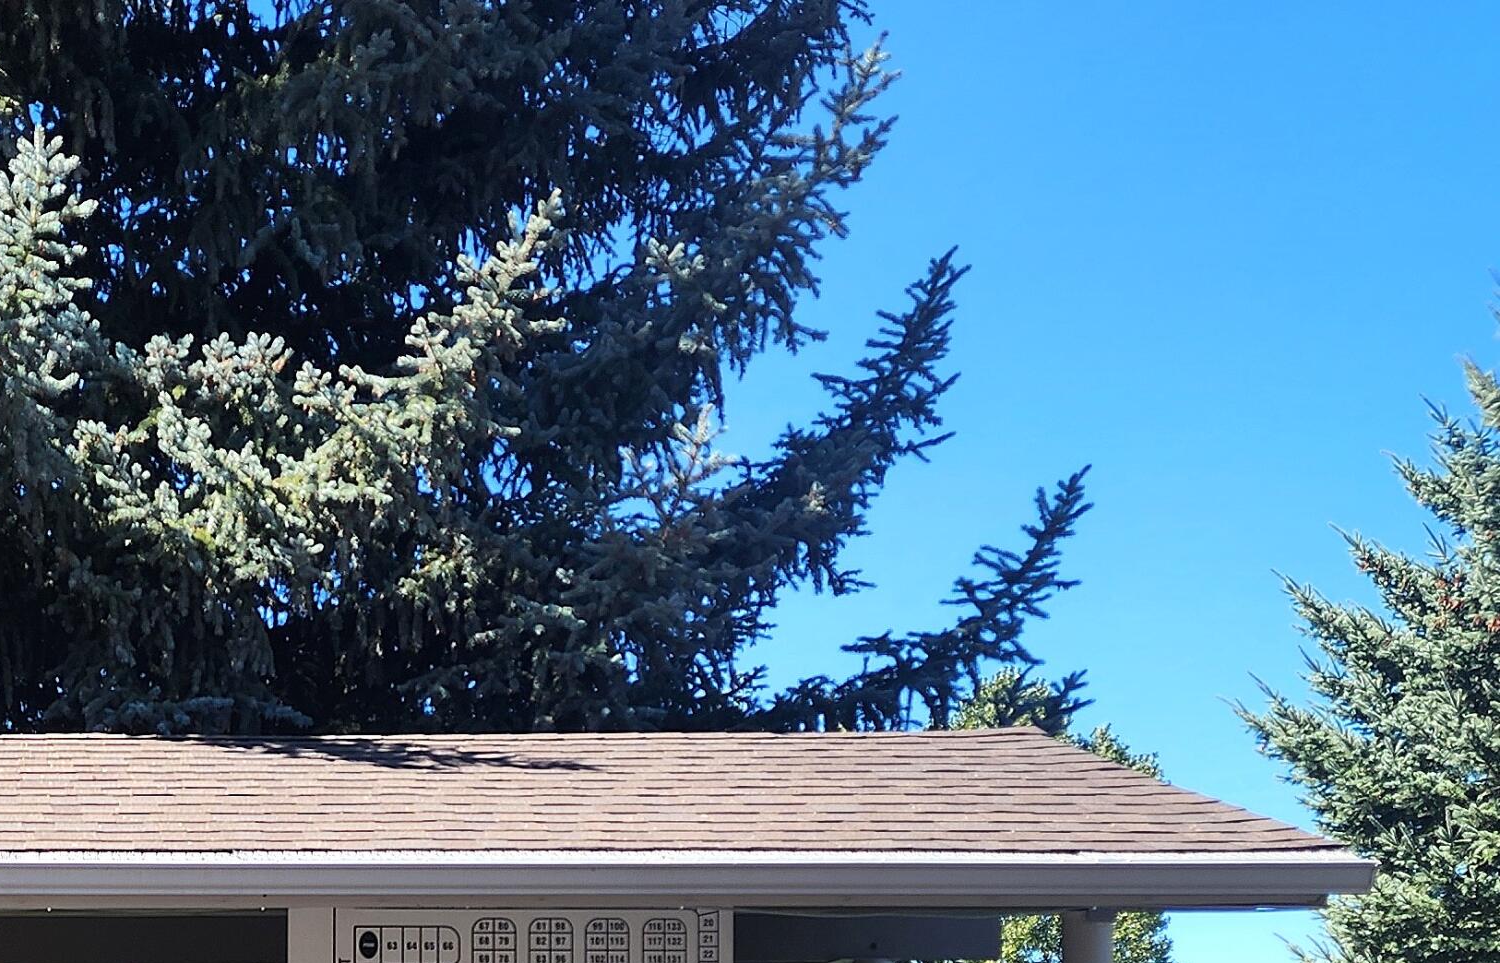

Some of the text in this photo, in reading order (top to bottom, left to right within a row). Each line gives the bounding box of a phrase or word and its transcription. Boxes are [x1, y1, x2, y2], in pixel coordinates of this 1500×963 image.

[499, 922, 509, 930] 80
[536, 922, 546, 930] 81
[479, 937, 489, 945] 68
[556, 937, 566, 945] 97
[591, 937, 604, 945] 101
[648, 937, 662, 945] 117
[703, 935, 712, 943] 21
[387, 942, 397, 950] 63
[407, 942, 417, 950] 64
[424, 942, 434, 950] 65
[443, 942, 453, 950] 66
[703, 950, 713, 958] 22
[479, 955, 489, 963] 69
[499, 955, 509, 963] 78
[536, 955, 546, 963] 83
[556, 955, 566, 963] 96
[591, 955, 605, 963] 102
[610, 955, 624, 963] 114
[668, 955, 681, 963] 131
